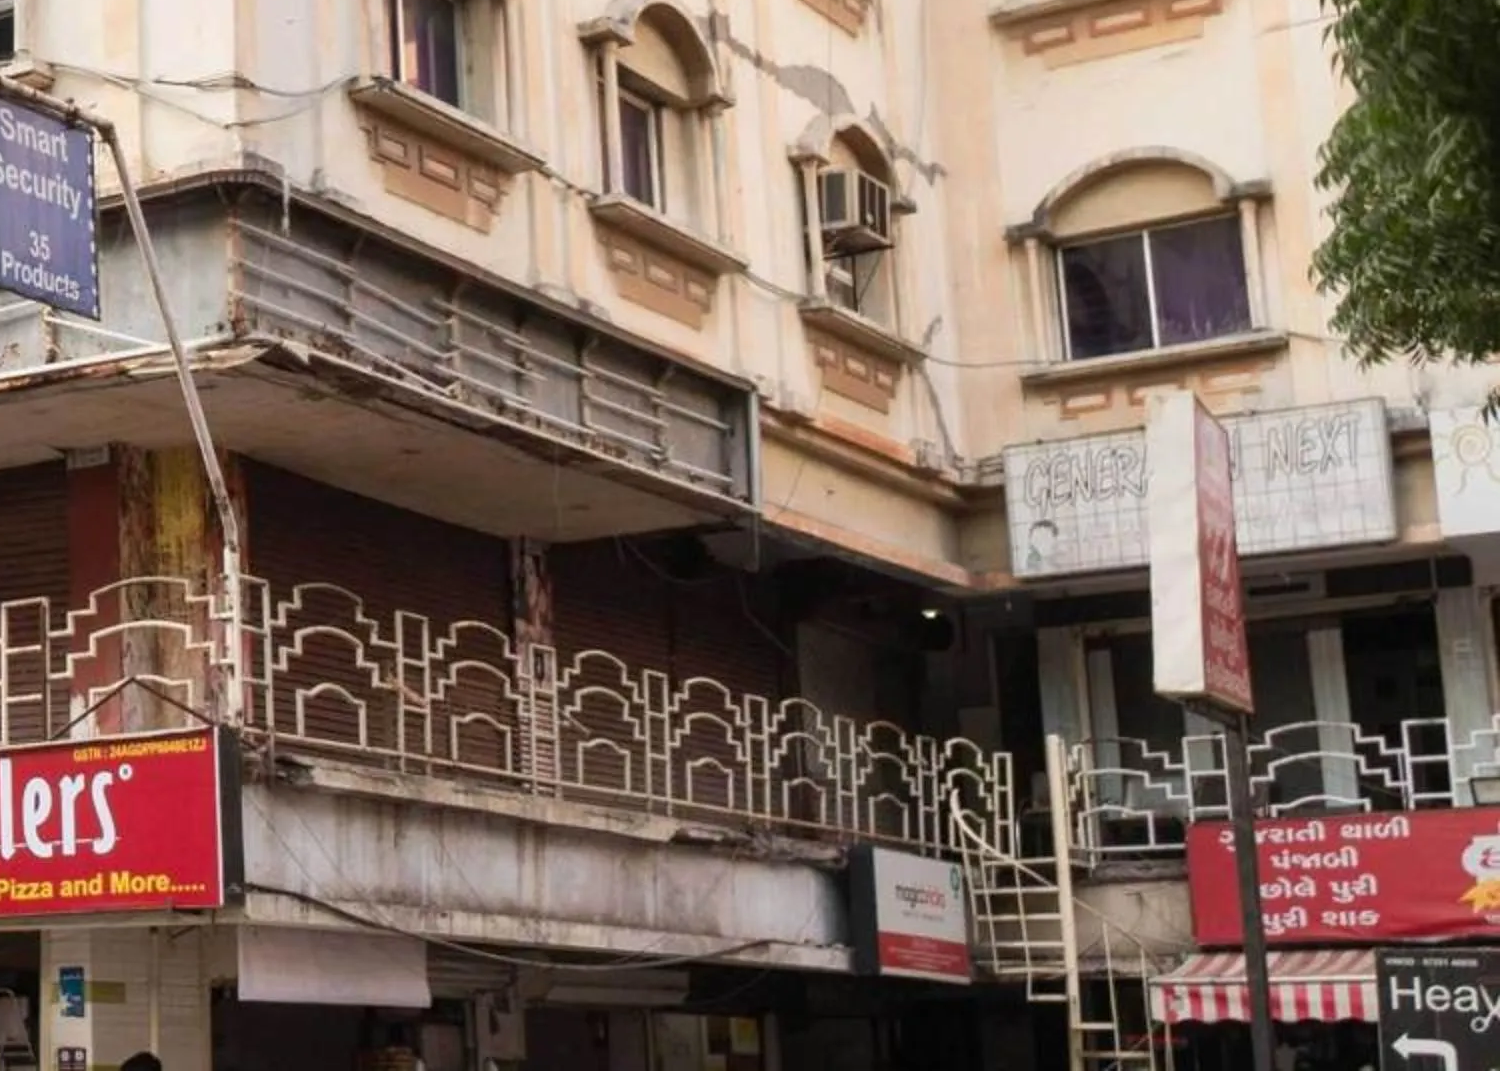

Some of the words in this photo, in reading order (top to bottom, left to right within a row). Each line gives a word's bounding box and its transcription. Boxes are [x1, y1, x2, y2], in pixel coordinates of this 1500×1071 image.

[0, 107, 68, 162] Smart
[29, 230, 51, 261] 35
[1, 250, 80, 301] Products
[1266, 409, 1363, 476] NEXT
[1269, 846, 1358, 870] પંજાબી
[60, 876, 103, 896] and
[1329, 874, 1378, 904] પુરી
